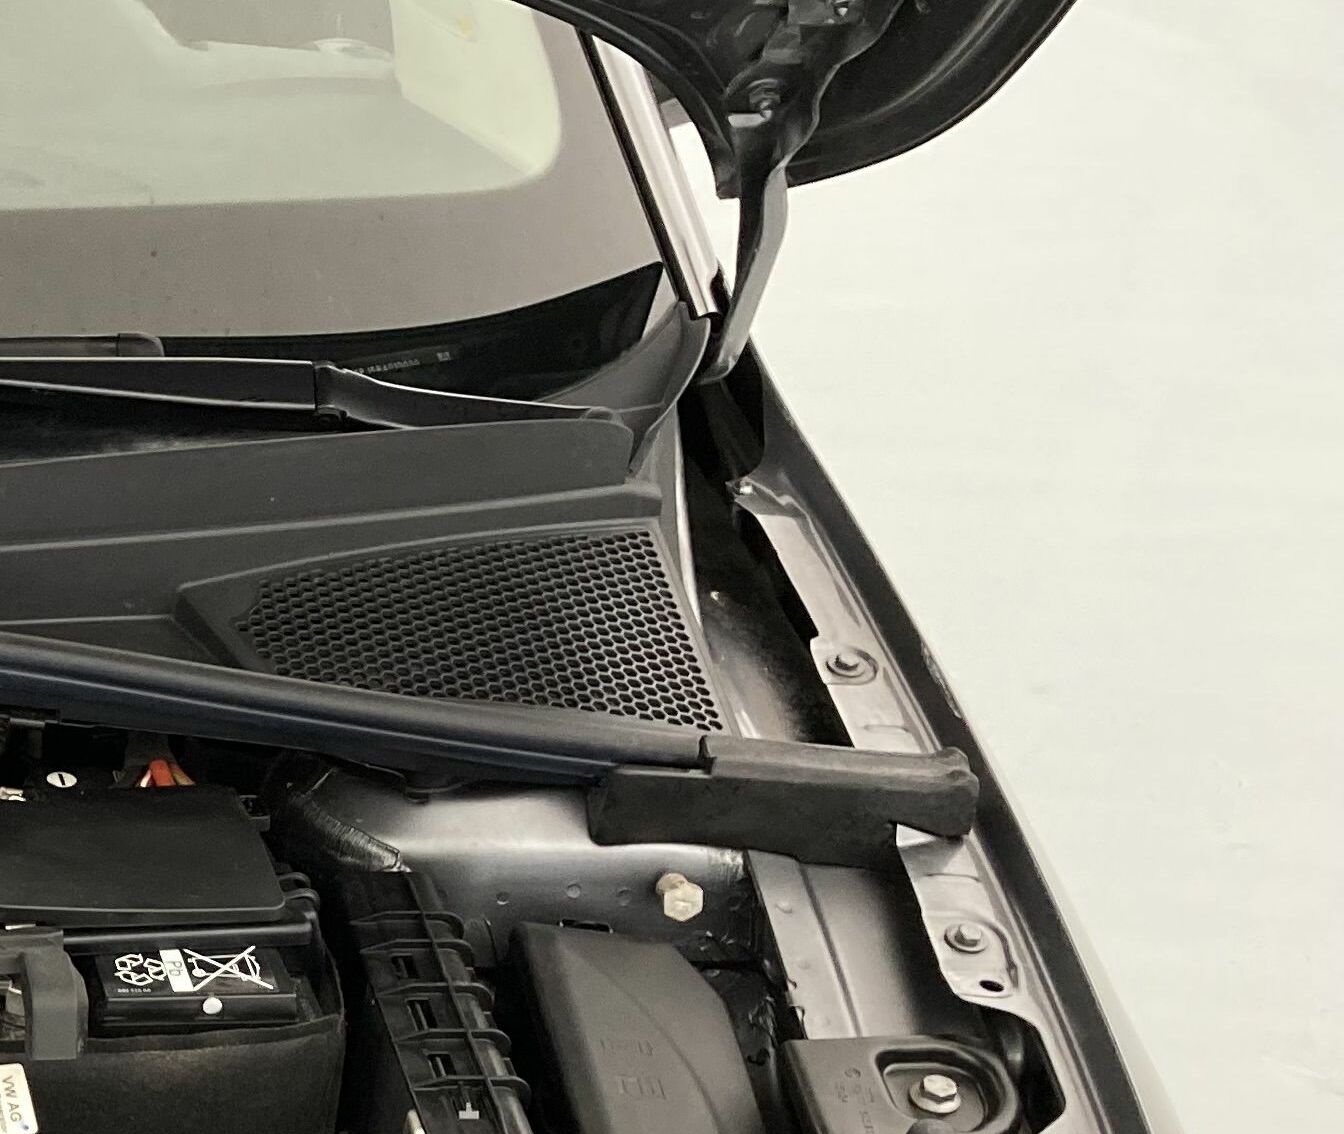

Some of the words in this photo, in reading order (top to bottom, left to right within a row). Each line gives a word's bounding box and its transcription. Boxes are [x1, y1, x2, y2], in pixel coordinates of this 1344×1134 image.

[167, 960, 183, 976] Pb
[2, 1075, 18, 1099] VW
[7, 1102, 22, 1122] AG
